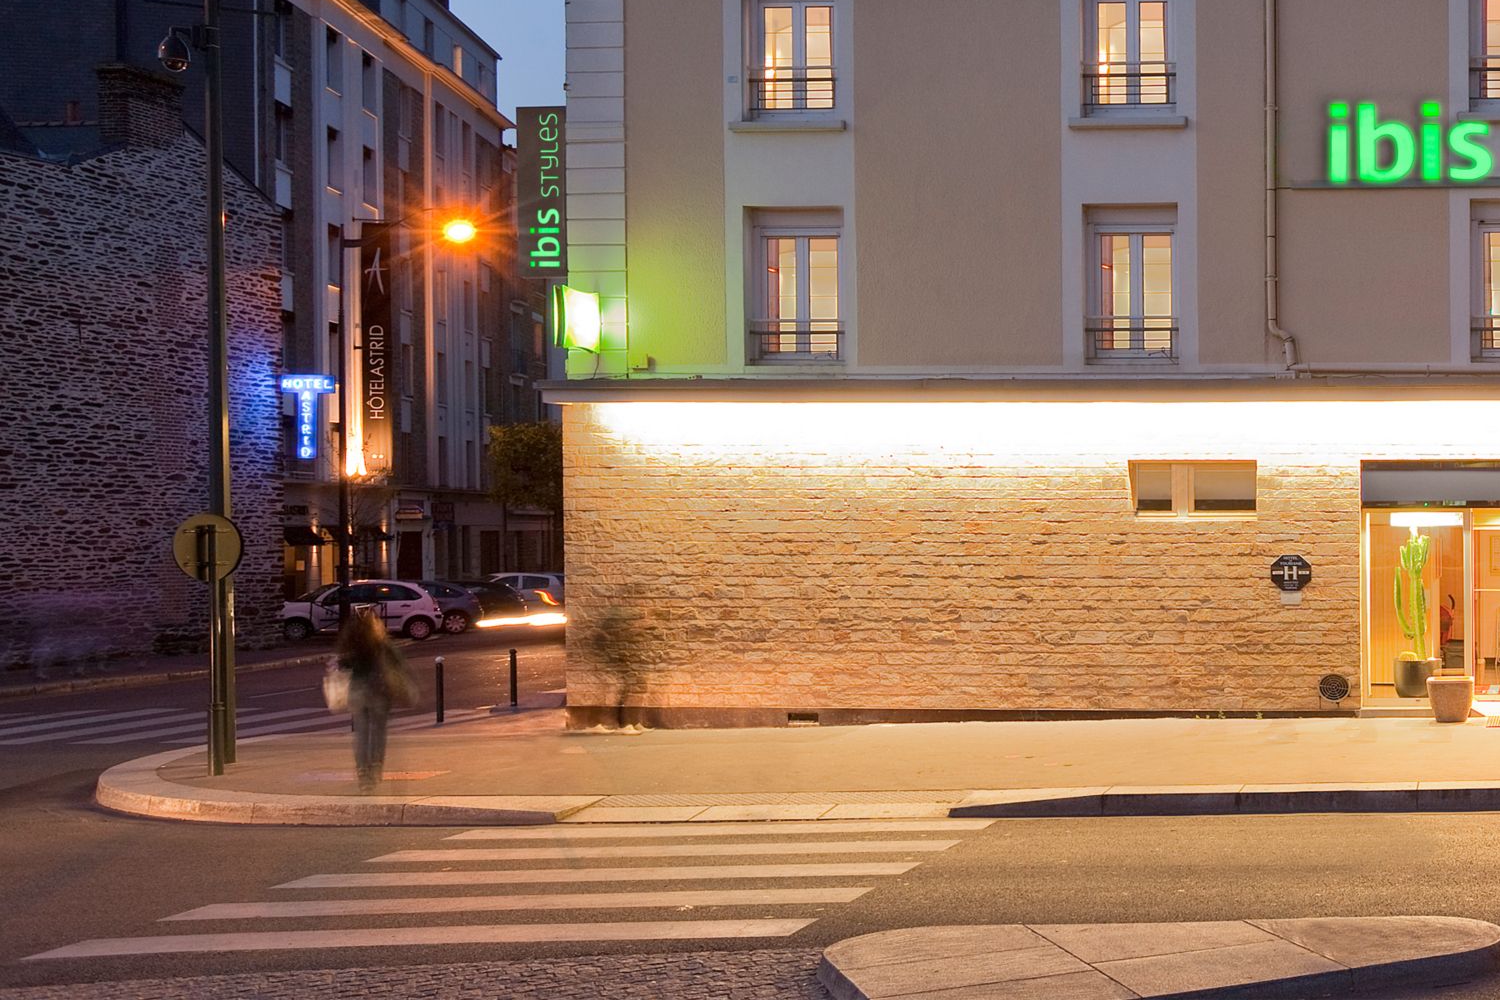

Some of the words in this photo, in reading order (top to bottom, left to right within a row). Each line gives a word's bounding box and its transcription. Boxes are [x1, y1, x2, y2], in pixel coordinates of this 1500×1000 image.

[1328, 101, 1493, 184] ibis
[528, 208, 561, 268] ibis
[281, 378, 333, 389] HOTEL
[300, 390, 313, 458] ASTRID
[1284, 566, 1298, 580] H
